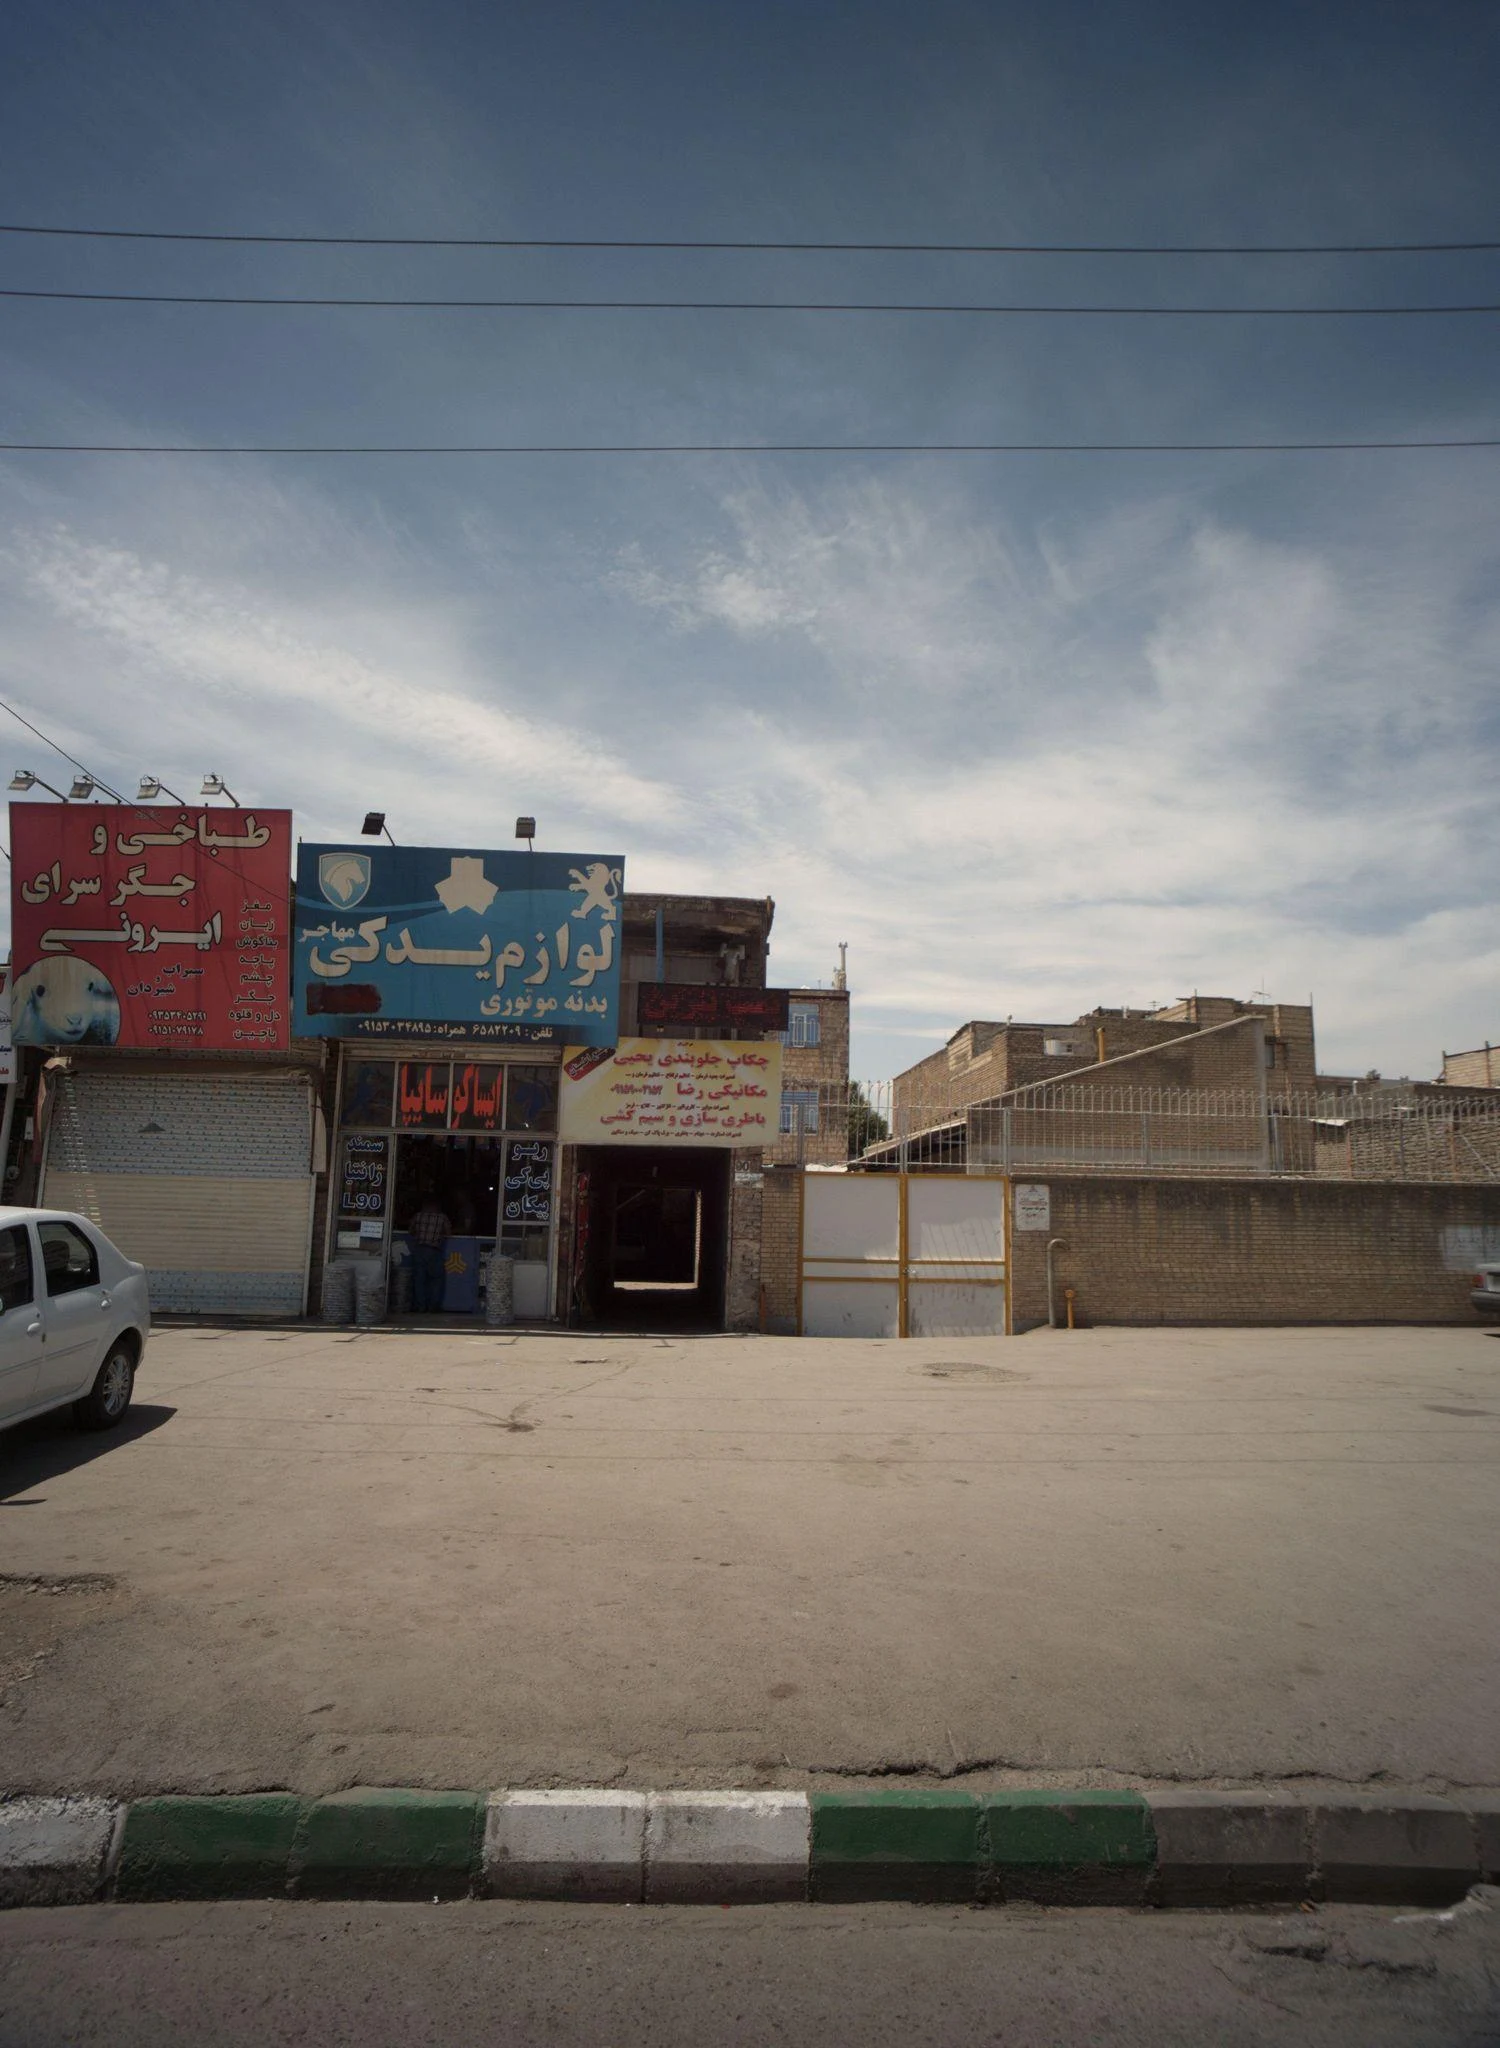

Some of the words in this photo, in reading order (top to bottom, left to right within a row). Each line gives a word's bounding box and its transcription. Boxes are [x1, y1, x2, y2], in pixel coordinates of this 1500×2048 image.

[90, 824, 109, 855] و
[116, 812, 272, 857] طباخی
[21, 859, 102, 905] سرای
[109, 864, 197, 906] جگر
[240, 899, 272, 913] مغز
[39, 911, 223, 952] ایرونی
[239, 917, 276, 932] زبان
[298, 920, 356, 943] مهاجر
[309, 916, 492, 982] یدکی
[496, 922, 617, 989] لوازم
[239, 953, 276, 969] پاچه
[240, 971, 274, 988] چشم
[234, 990, 277, 1005] جگر
[480, 989, 558, 1018] موتوری
[564, 990, 609, 1015] بدنه
[264, 1008, 281, 1023] دل
[233, 1025, 277, 1042] پاچین
[727, 1052, 769, 1071] چکاپ
[400, 1063, 448, 1125] سایپا
[676, 1082, 704, 1100] رضا
[708, 1083, 769, 1100] مکانیکی
[346, 1136, 384, 1154] سمند
[512, 1142, 548, 1162] ریو
